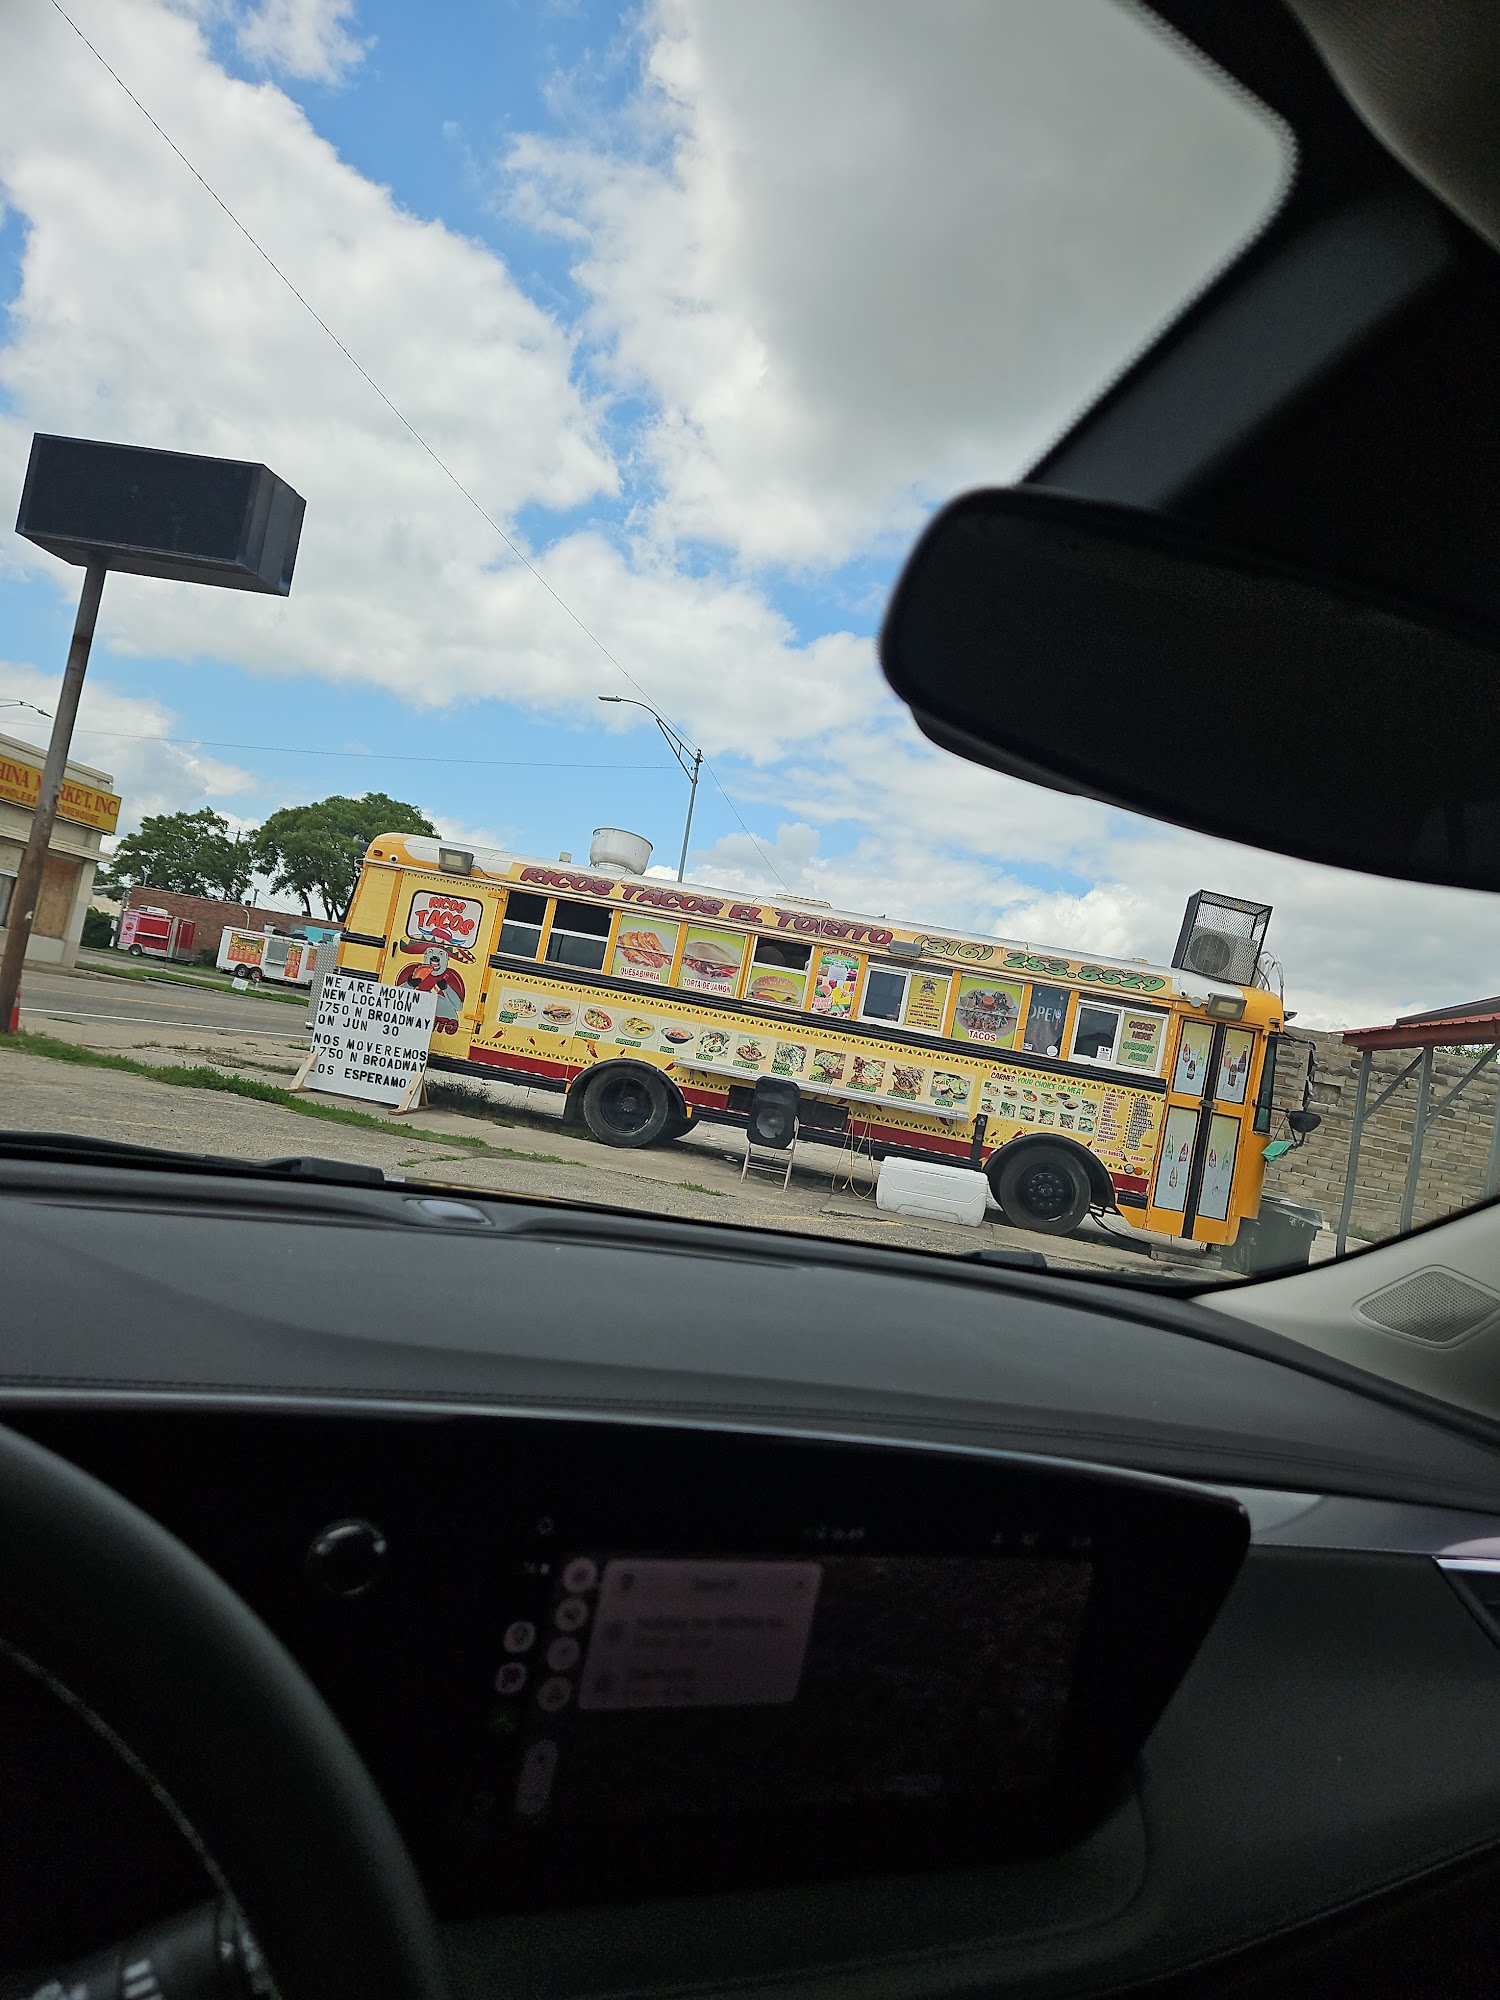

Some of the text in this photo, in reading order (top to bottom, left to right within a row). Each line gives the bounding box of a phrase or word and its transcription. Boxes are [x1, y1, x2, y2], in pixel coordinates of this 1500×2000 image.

[0, 761, 29, 788] HINA
[95, 795, 117, 817] INC.
[428, 896, 467, 914] RICOS
[415, 909, 475, 936] TACOS
[520, 867, 1165, 992] RICOS TACOS EL TORITO (316) 253.8529
[620, 966, 660, 981] QUESABIRRIA
[325, 975, 420, 1003] WE ARE MOVIN
[683, 978, 732, 993] TORTA DE JAMÓN
[322, 988, 412, 1012] NEW LOCATION
[318, 1014, 399, 1036] ON JUN 30
[319, 1001, 349, 1015] 1750
[355, 1007, 362, 1017] N
[368, 1009, 430, 1029] BROADWAY
[1129, 1020, 1156, 1032] ORDER
[314, 1032, 427, 1061] NOS MOVEREMOS
[968, 1029, 997, 1042] TACOS
[1131, 1031, 1153, 1040] HERE
[311, 1046, 425, 1073] 1750 N BROADWAY
[696, 1053, 713, 1061] TACOS
[344, 1068, 411, 1088] ESPERAMO
[990, 1072, 1016, 1082] CARNES
[1017, 1077, 1033, 1086] YOUR
[1035, 1081, 1056, 1090] CHOICE
[1066, 1086, 1085, 1095] MEAT
